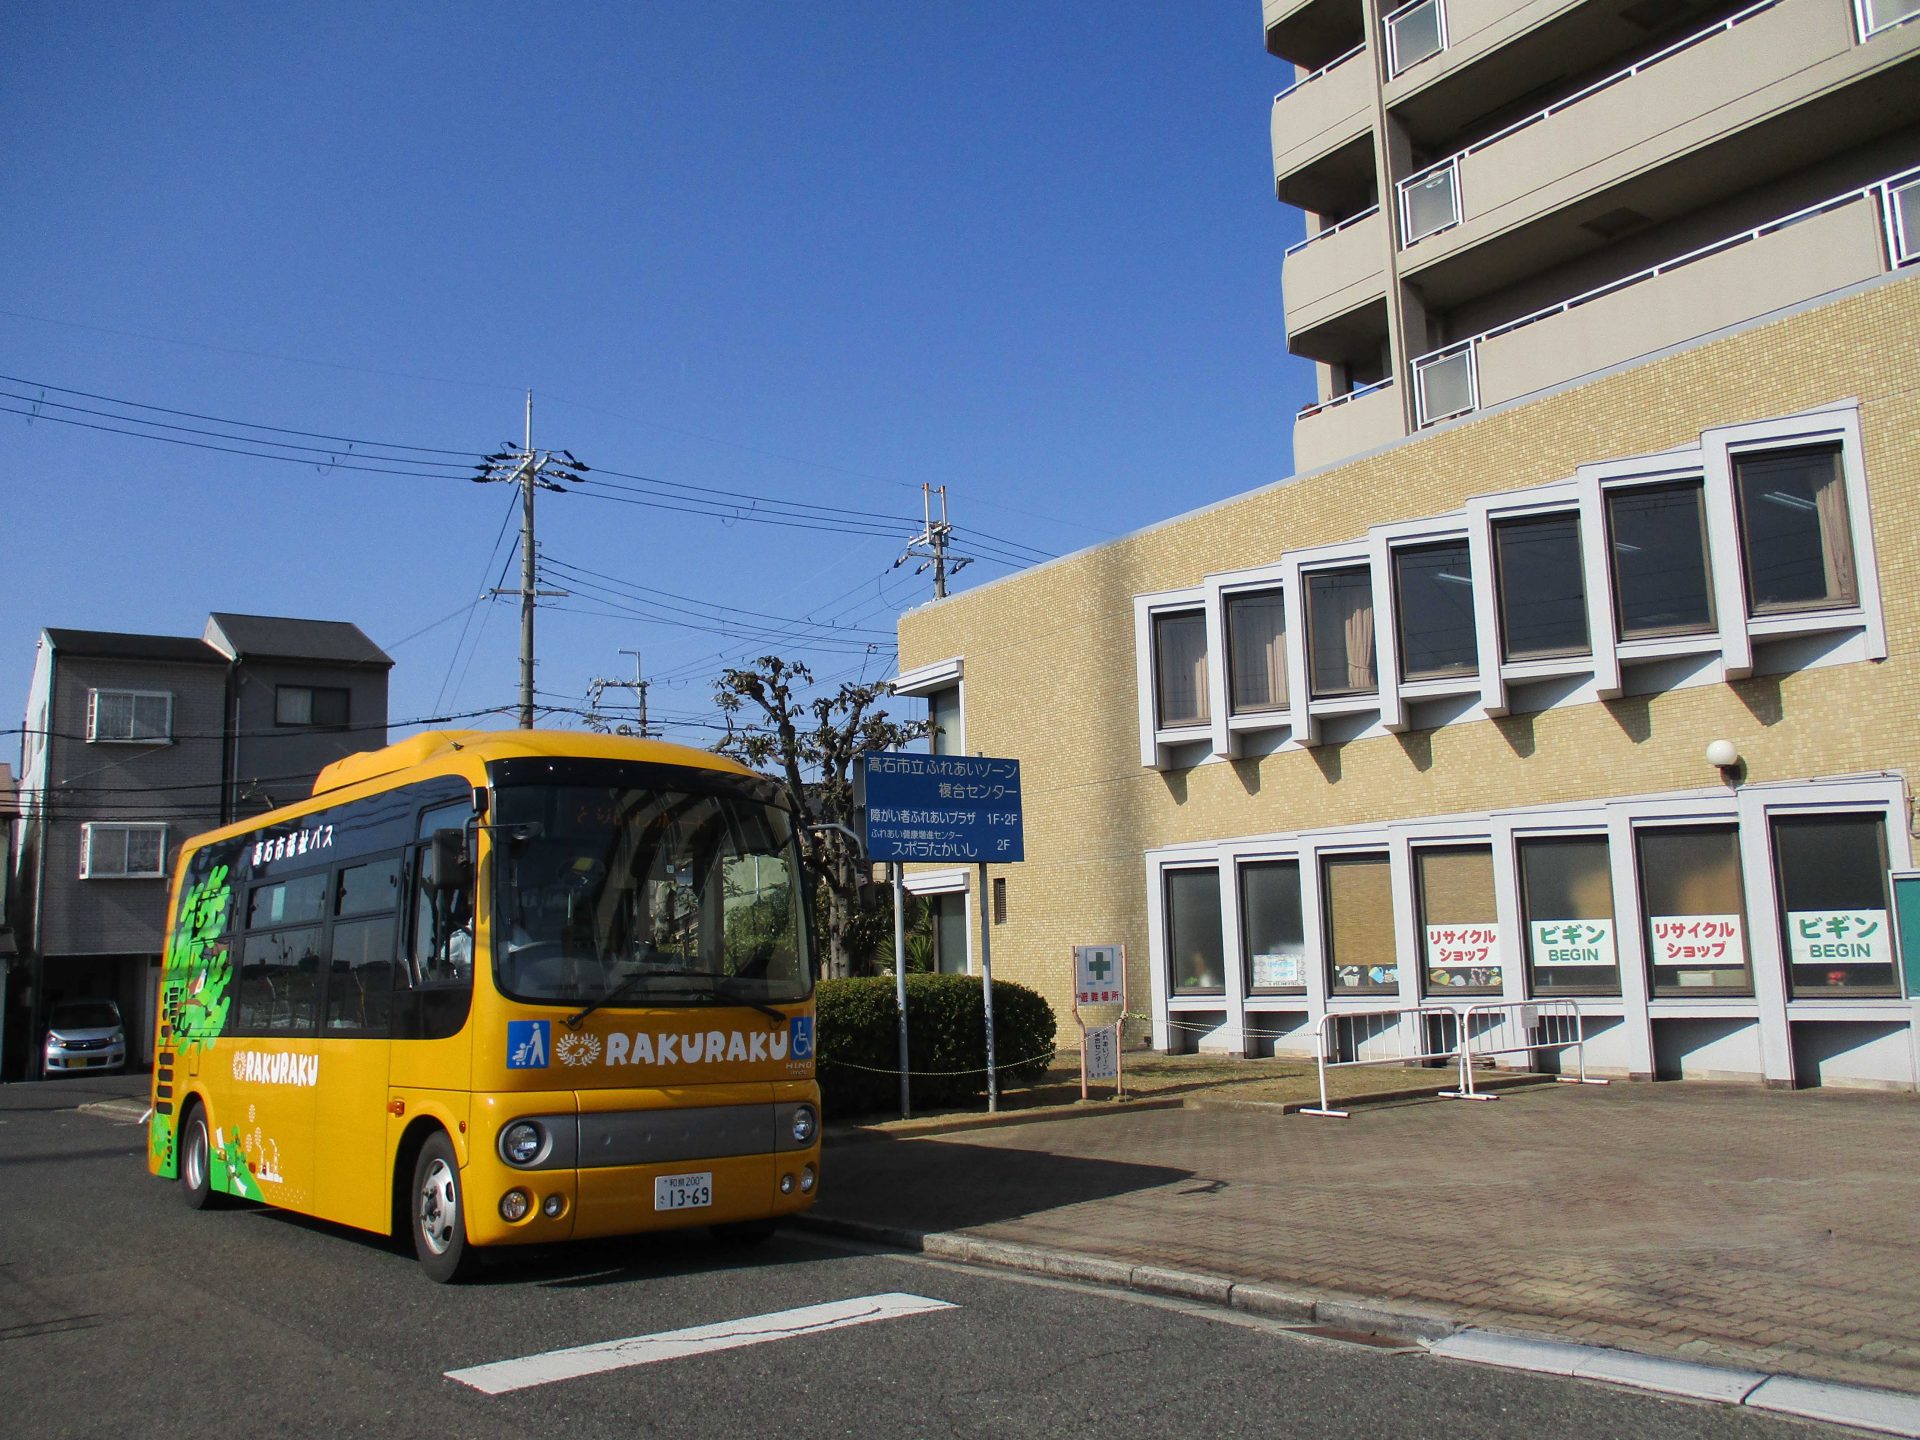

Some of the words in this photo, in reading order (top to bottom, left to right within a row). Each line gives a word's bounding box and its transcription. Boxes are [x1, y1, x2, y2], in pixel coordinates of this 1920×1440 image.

[868, 757, 1017, 779] 高石市立ふれあいゾーン
[938, 782, 1017, 799] 複合センター
[870, 808, 976, 825] 障がい者ふれあいプラザ
[871, 829, 963, 840] ふれあい健康増進センター
[252, 824, 334, 866] 高石市福祉バス
[891, 841, 978, 857] スポラたかいし
[996, 839, 1010, 851] 2F
[1540, 925, 1605, 946] ビギン
[1655, 922, 1735, 939] リサイクル
[1799, 915, 1878, 939] ビギン
[1429, 929, 1497, 945] リサイクル
[1440, 946, 1490, 962] ショップ
[1548, 948, 1599, 961] BEGIN
[1667, 941, 1727, 959] ショップ
[1809, 943, 1871, 958] BEGIN
[605, 1030, 788, 1067] RAKURAKU
[245, 1050, 319, 1087] RAKURAKU
[686, 1176, 700, 1187] 200
[670, 1186, 709, 1208] 13-69
